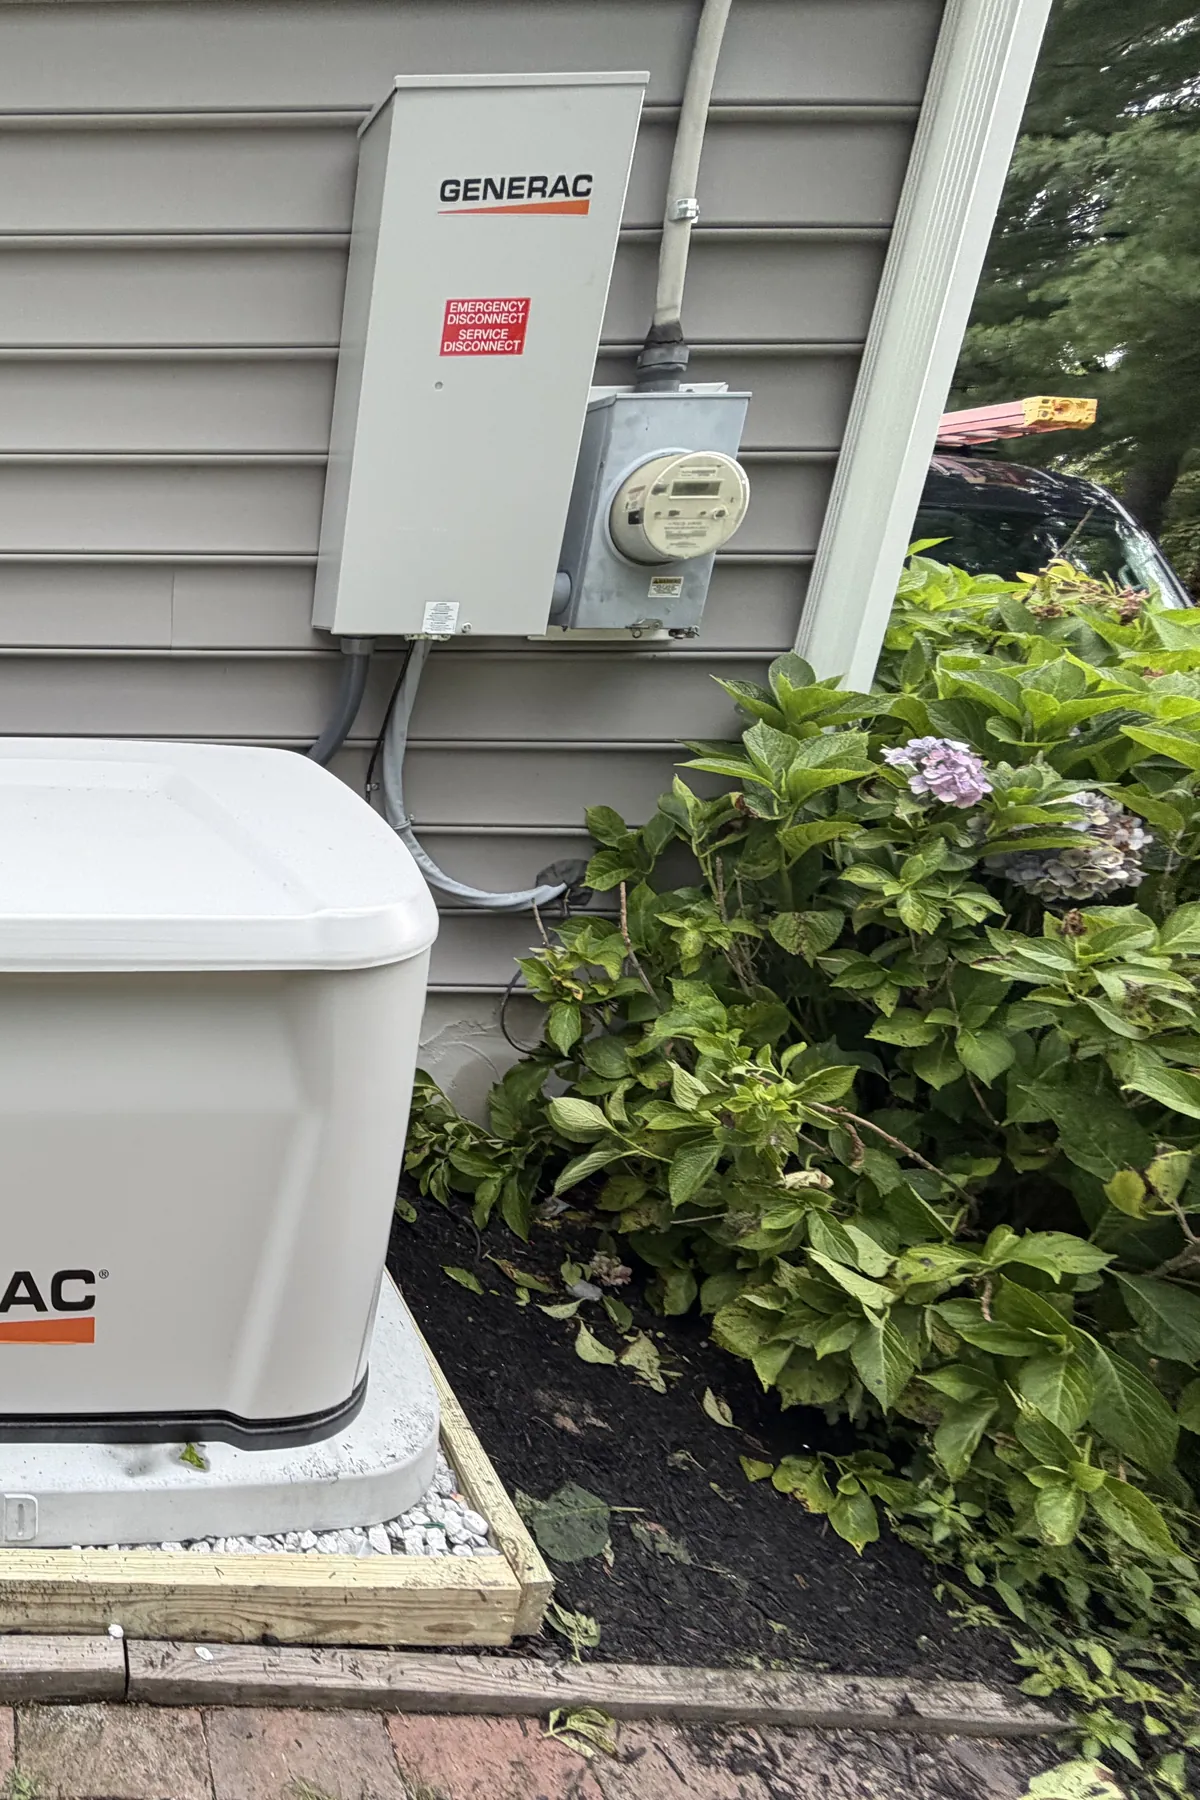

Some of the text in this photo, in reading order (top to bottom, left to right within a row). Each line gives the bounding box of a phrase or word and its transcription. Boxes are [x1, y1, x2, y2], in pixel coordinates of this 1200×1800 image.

[439, 174, 594, 203] GENERAC
[449, 300, 526, 314] EMERGENCY
[446, 312, 525, 325] DISCONNECT
[458, 328, 509, 341] SERVICE
[443, 339, 522, 353] DISCONNECT
